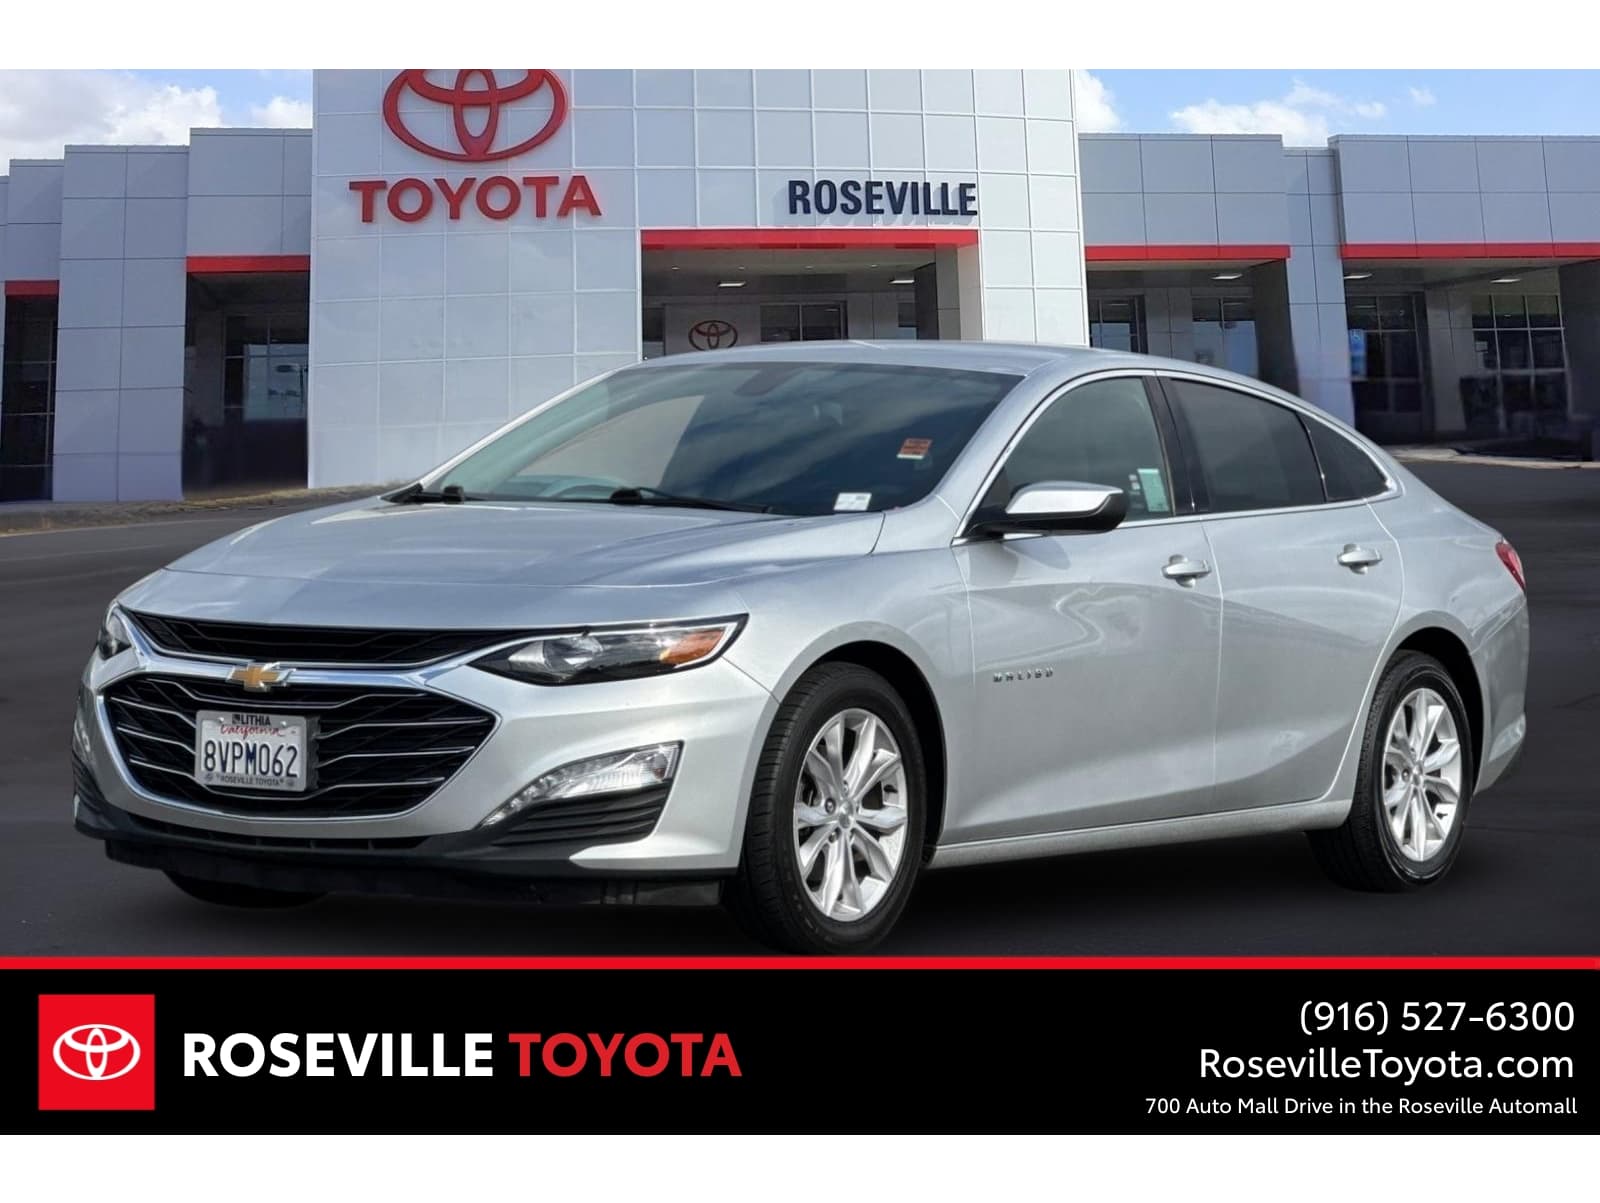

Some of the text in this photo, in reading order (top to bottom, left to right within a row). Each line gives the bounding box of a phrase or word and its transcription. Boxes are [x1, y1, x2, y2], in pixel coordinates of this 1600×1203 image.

[349, 175, 602, 223] TOYOTA
[788, 179, 978, 216] ROSEVILLE
[220, 724, 286, 740] California
[240, 714, 271, 726] LITHIA
[204, 739, 298, 778] 8VPM062
